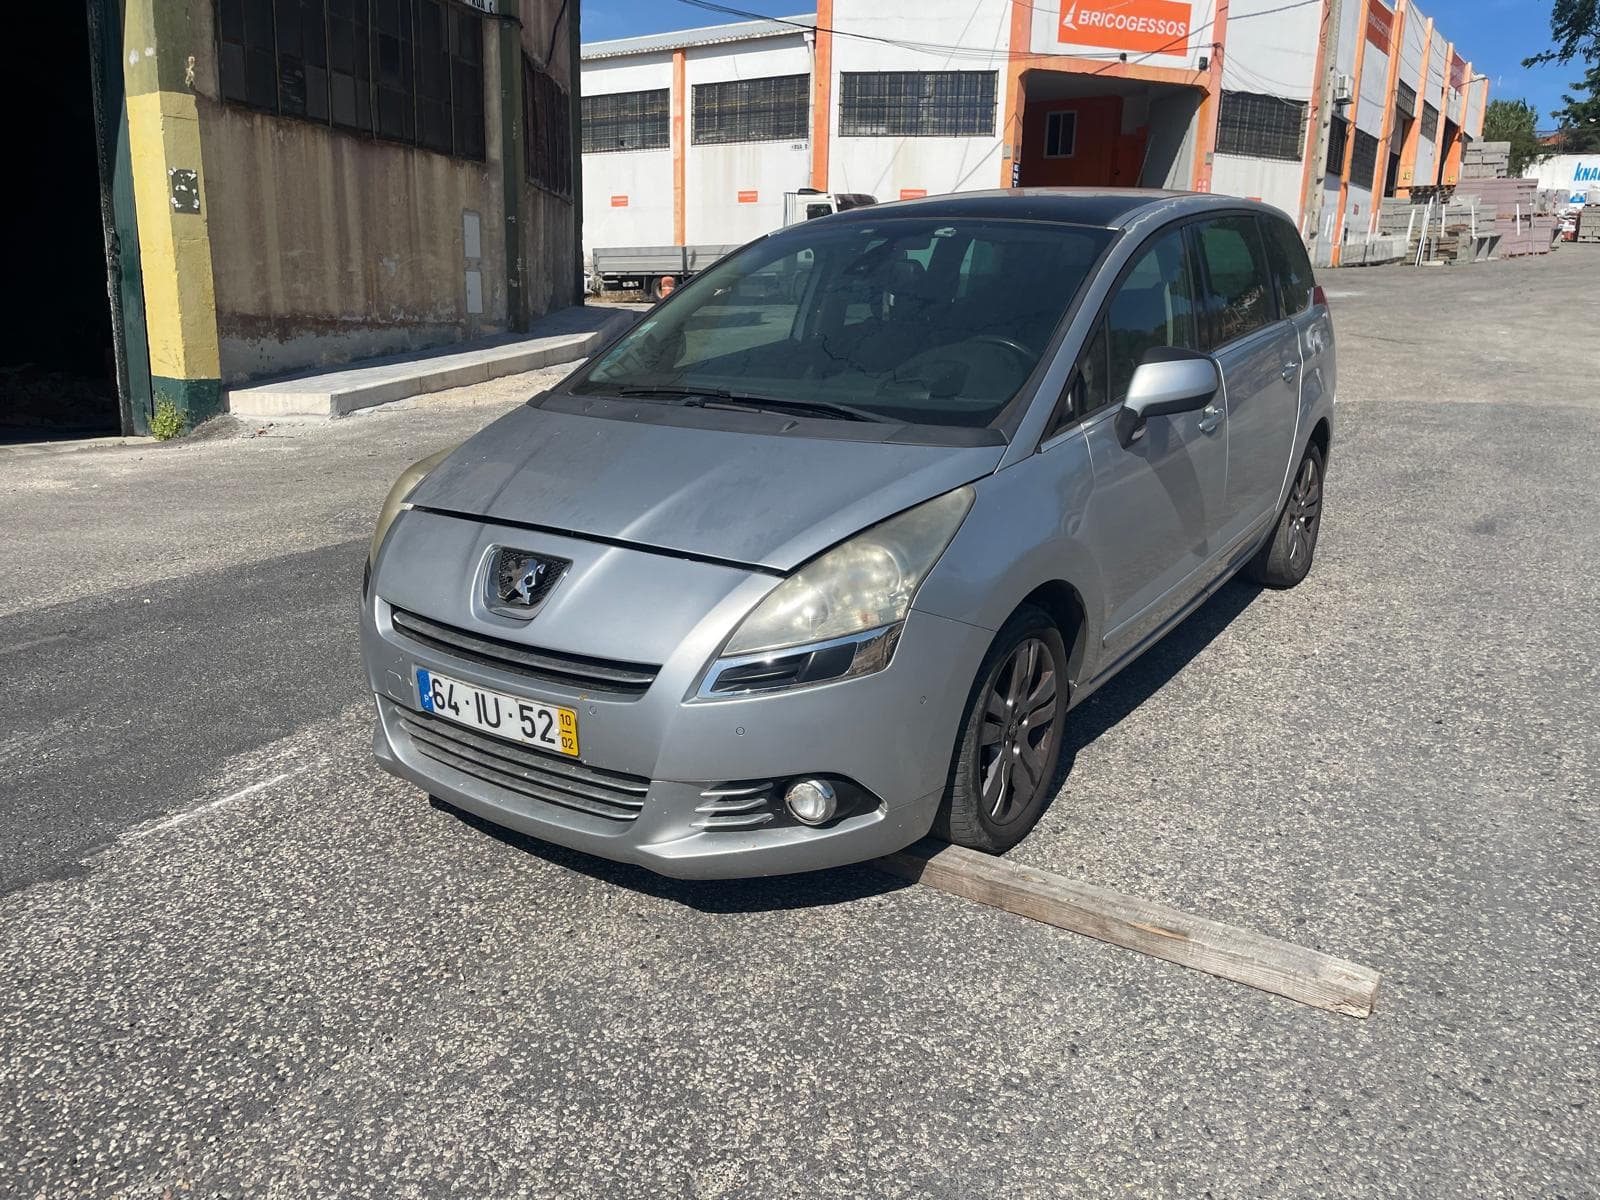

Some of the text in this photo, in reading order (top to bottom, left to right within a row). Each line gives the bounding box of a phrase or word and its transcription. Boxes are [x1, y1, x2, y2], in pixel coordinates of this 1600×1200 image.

[1078, 10, 1186, 37] BRICOGESSOS
[559, 713, 572, 727] 10
[561, 738, 574, 750] 02
